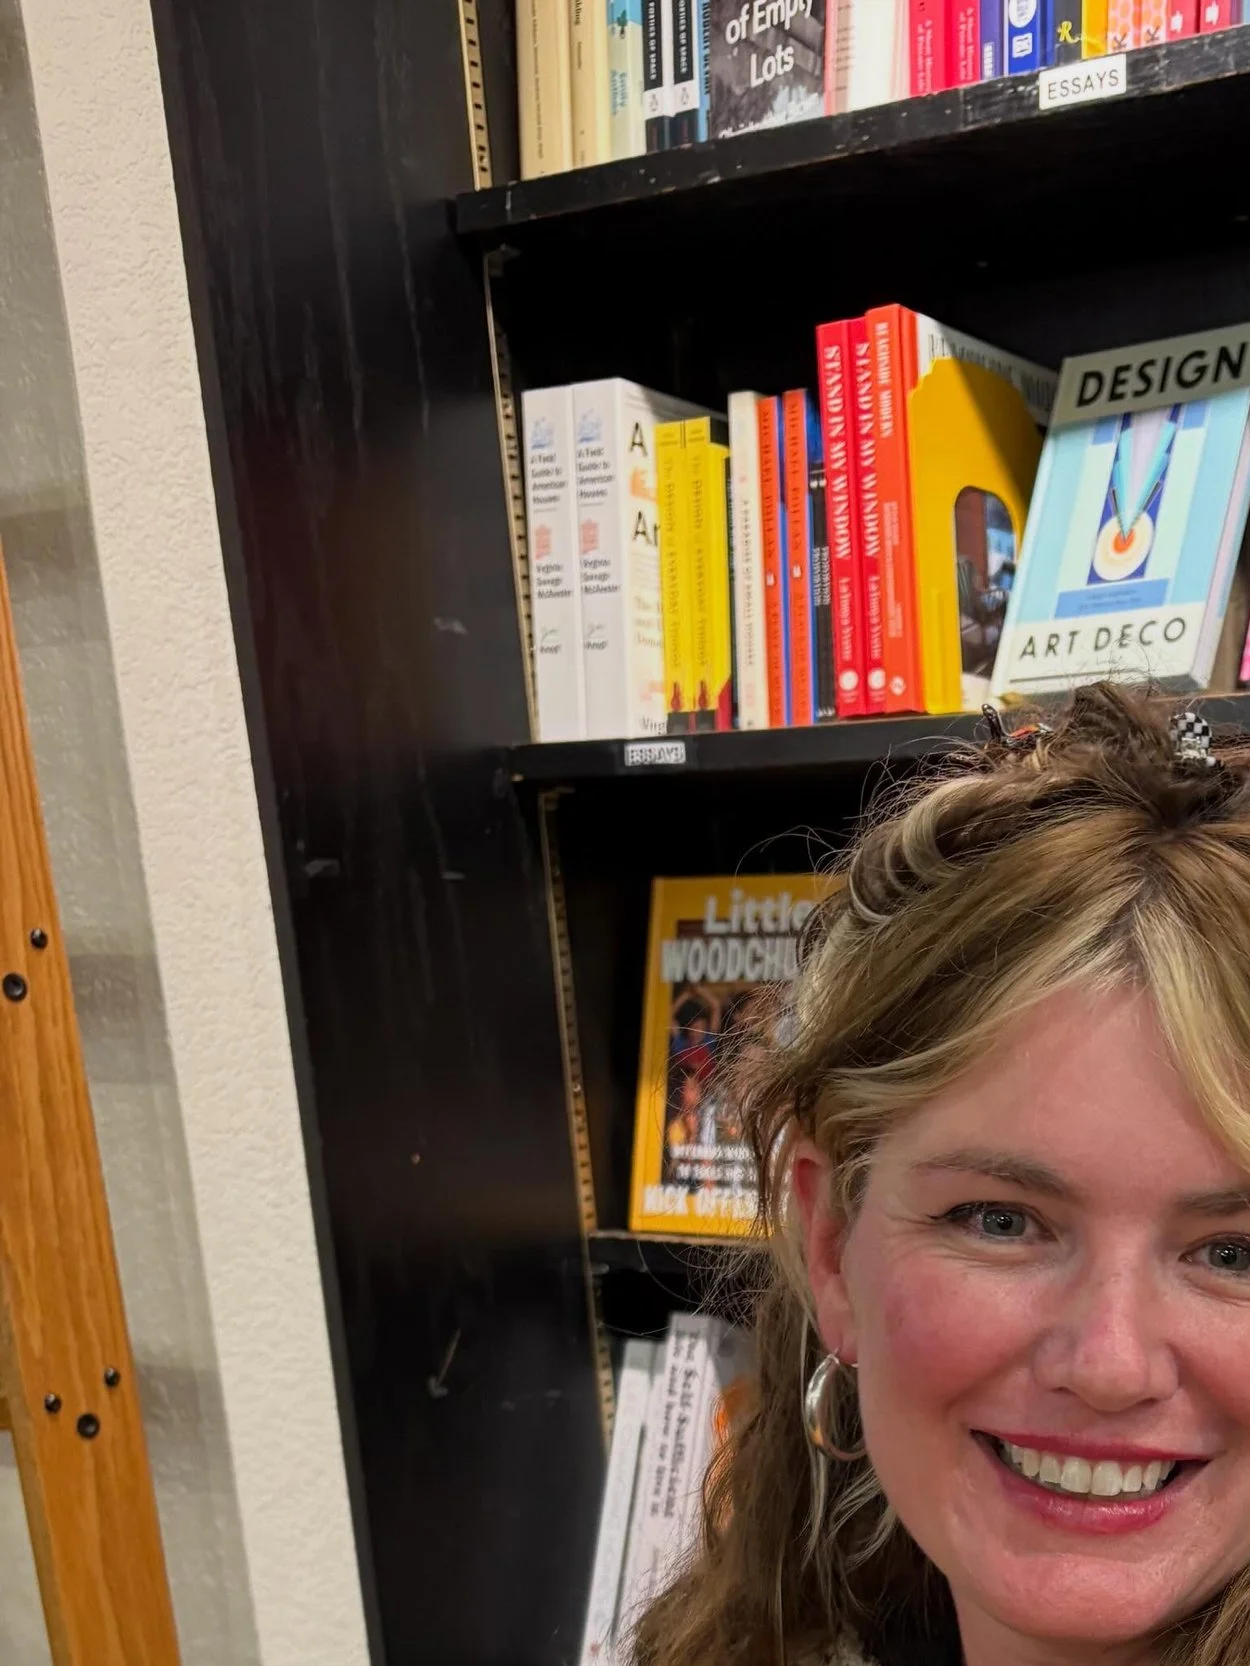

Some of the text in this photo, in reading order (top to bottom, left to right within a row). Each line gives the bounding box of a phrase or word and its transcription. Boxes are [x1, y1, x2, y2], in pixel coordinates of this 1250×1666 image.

[725, 3, 750, 44] of
[751, 44, 794, 88] Lots
[1047, 69, 1120, 101] ESSAYS
[1076, 342, 1249, 407] DESIGN
[628, 421, 648, 458] A
[824, 345, 852, 560] STAND IN MY WINDOW
[855, 342, 880, 557] STAND IN MY WINDOW
[1019, 617, 1187, 660] ART DECO
[630, 747, 684, 765] ESSAYS
[703, 889, 815, 934] Little
[661, 937, 799, 982] WOODCHU
